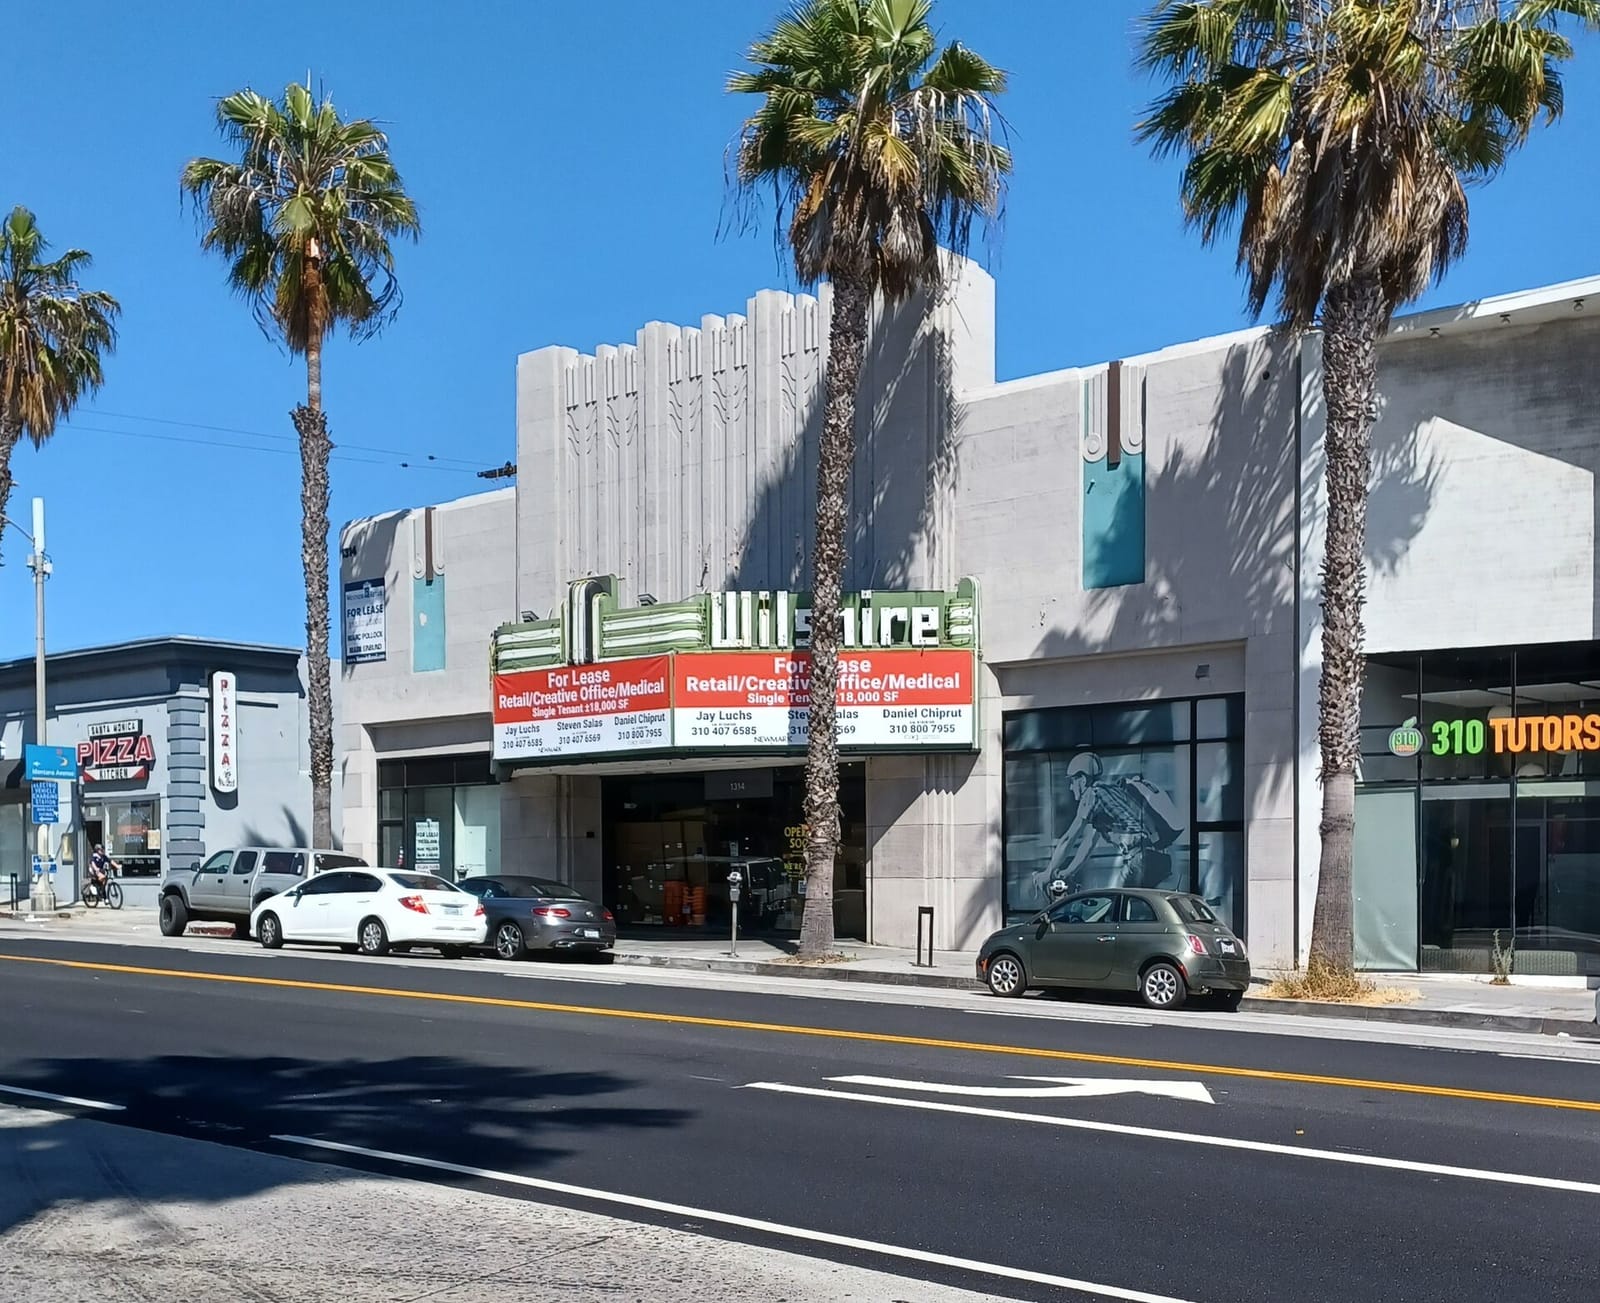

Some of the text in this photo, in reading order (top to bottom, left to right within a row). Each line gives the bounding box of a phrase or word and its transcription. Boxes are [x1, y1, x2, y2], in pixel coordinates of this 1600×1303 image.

[347, 604, 384, 618] FOR LEASE
[774, 657, 806, 674] For
[548, 670, 610, 688] For Lease
[686, 672, 960, 692] Retail/Creativ ffice/Medical
[498, 677, 664, 709] Retail/Creative Office/Medical
[748, 693, 785, 705] Single
[836, 692, 880, 704] 18,000
[883, 691, 899, 702] SF
[532, 699, 630, 718] Single Tenant ±18,000 SF
[788, 709, 858, 720] Stev alas
[882, 708, 962, 720] Daniel Chiprut
[614, 713, 666, 726] Daniel Chiprut
[696, 710, 752, 722] Jay Luchs
[91, 722, 136, 734] SANTA MONICA
[220, 679, 230, 766] PIZZA
[557, 718, 603, 730] Steven Salas
[506, 724, 540, 736] Jay Luchs
[618, 728, 662, 740] 310 800 7955
[692, 726, 757, 736] 310 407 6585
[790, 725, 856, 734] 310 569
[890, 724, 956, 734] 310 800 7955
[1432, 714, 1600, 755] 310 TUTORS
[503, 740, 514, 749] 310
[516, 740, 526, 748] 407
[528, 738, 542, 747] 6585
[559, 734, 600, 744] 310 407 6569
[77, 735, 153, 766] PIZZA
[100, 768, 128, 779] KITCHEN
[730, 782, 745, 791] 1314
[790, 838, 808, 848] SOO
